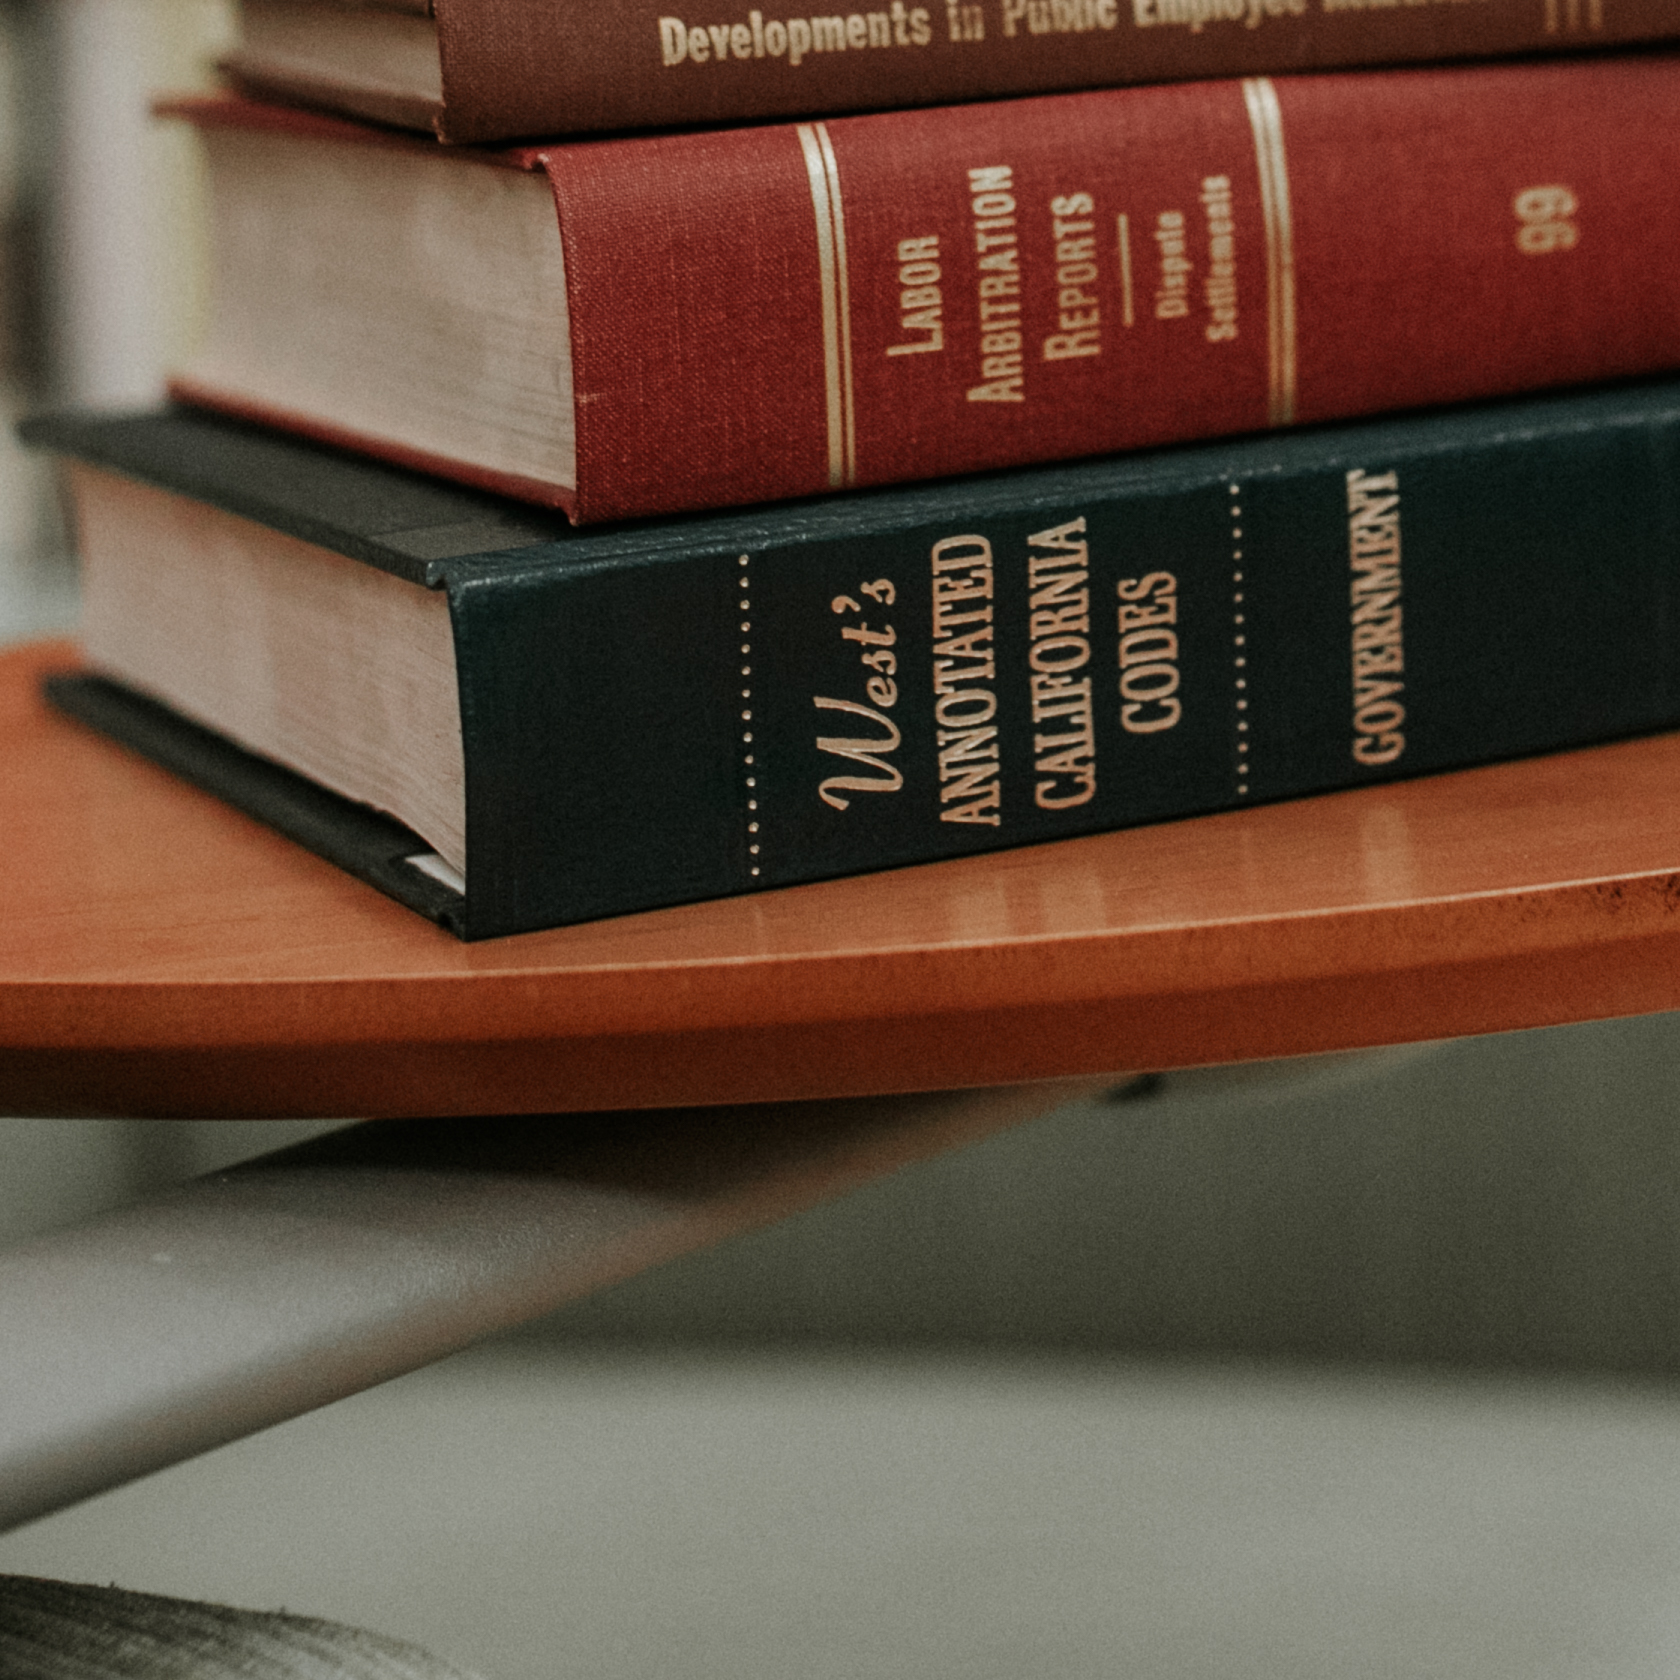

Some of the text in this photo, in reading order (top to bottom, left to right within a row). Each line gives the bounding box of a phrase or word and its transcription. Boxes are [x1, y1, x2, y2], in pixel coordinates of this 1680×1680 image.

[657, 0, 933, 68] Developments
[885, 233, 946, 359] LABOR
[965, 163, 1026, 404] ARBITRATION
[1042, 190, 1103, 363] REPORTS
[1153, 210, 1192, 321] Dispute
[1198, 174, 1239, 344] Settlements
[1512, 184, 1580, 255] 99
[812, 577, 906, 813] West's
[930, 533, 1003, 829] ANNOTATED
[1025, 515, 1098, 811] CALIFORNIA
[1116, 570, 1184, 736] CODES
[1344, 466, 1406, 767] GOVERNMENT
